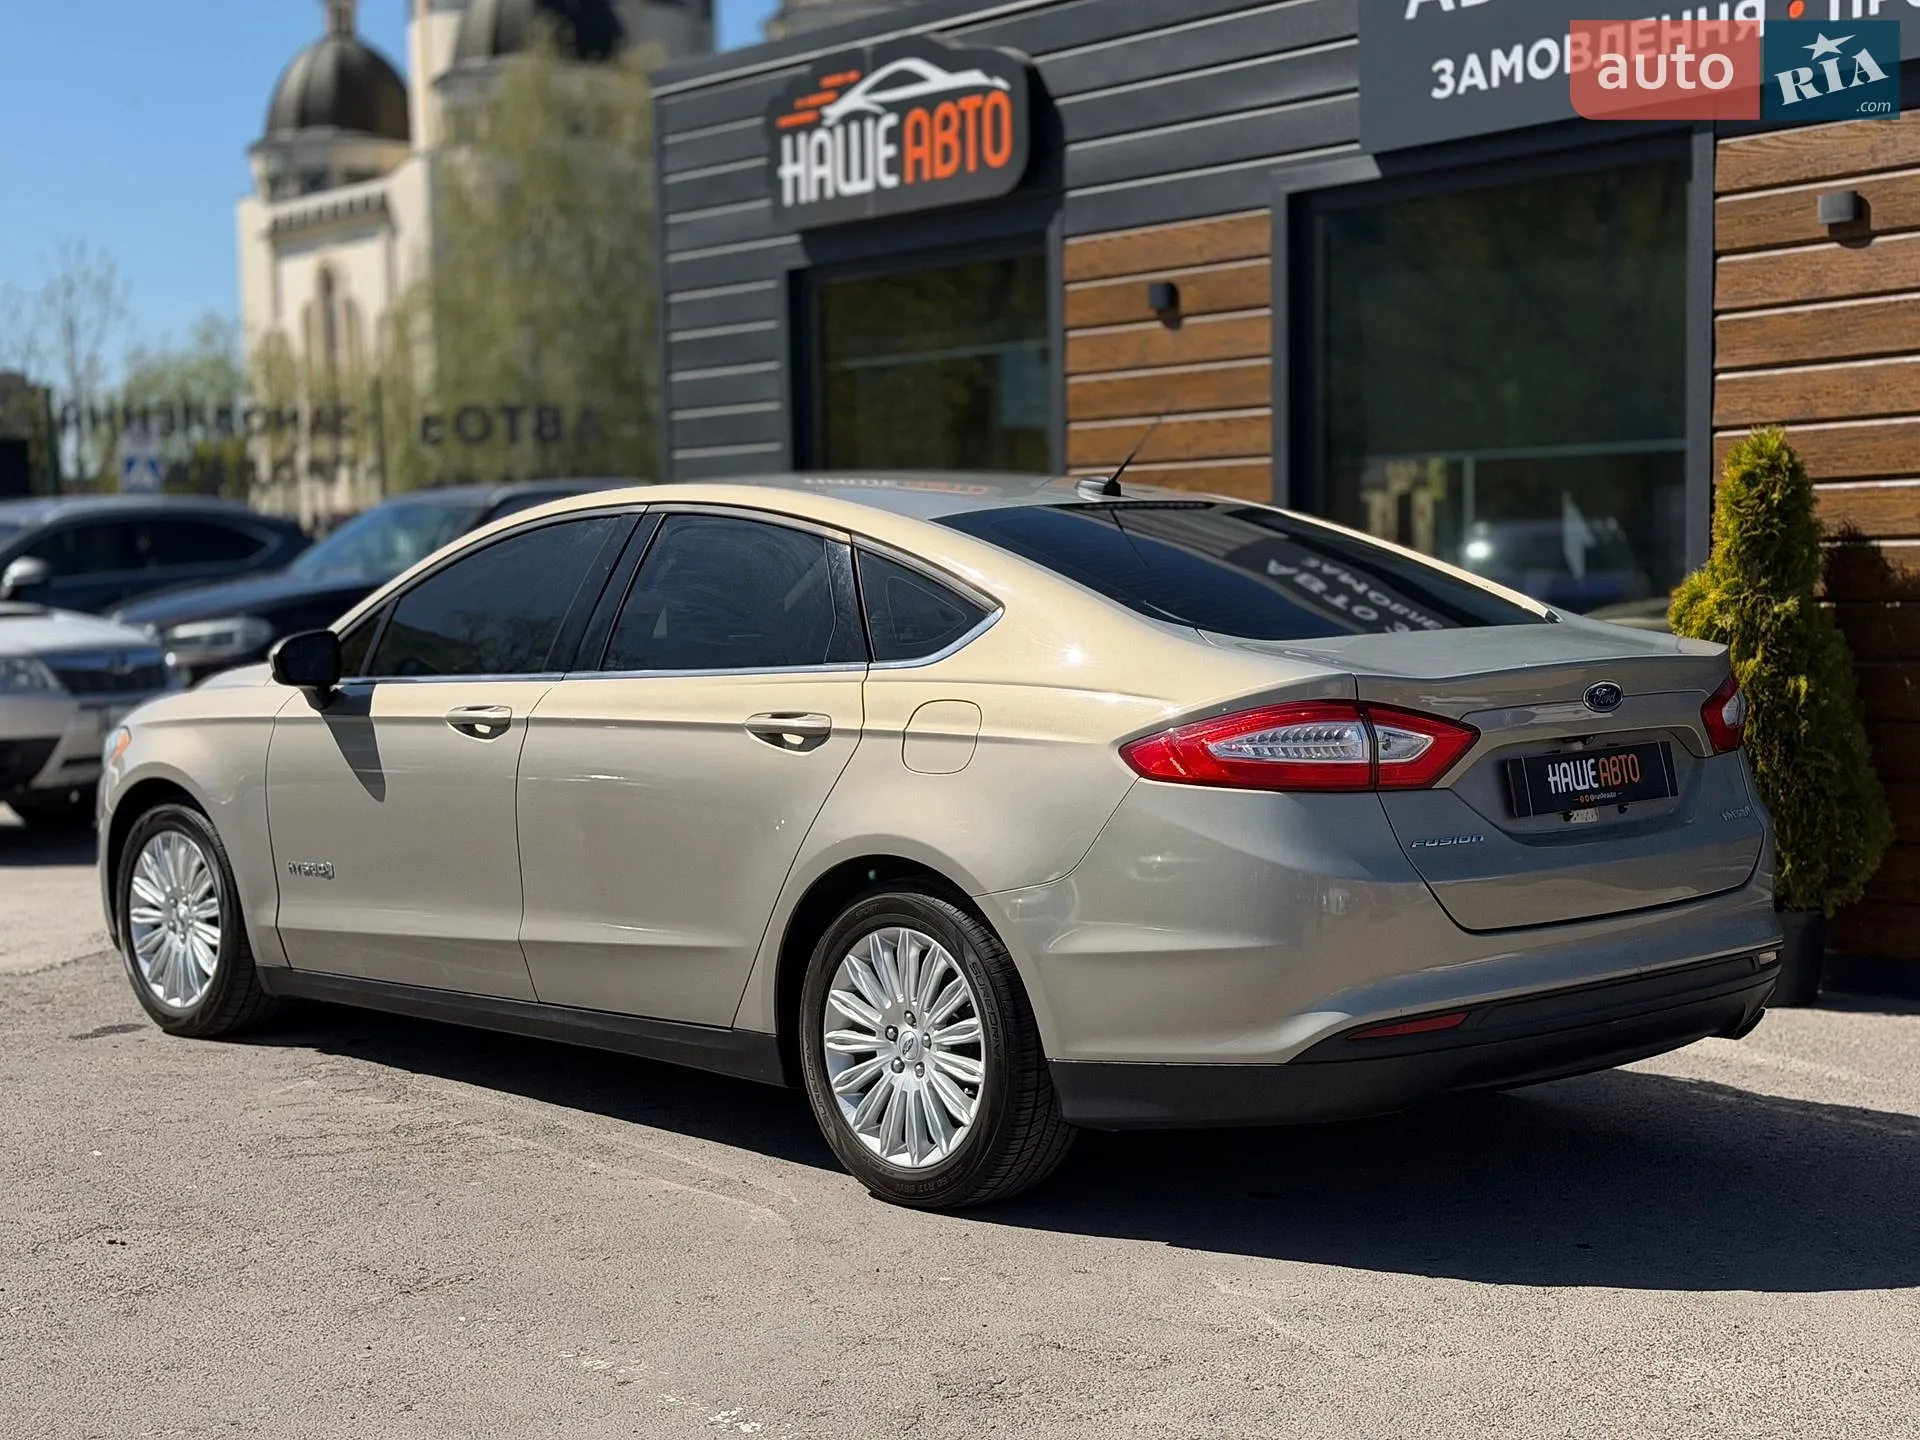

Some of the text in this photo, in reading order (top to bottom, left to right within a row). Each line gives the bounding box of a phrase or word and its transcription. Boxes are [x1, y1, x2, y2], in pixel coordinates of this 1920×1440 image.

[1431, 0, 1766, 99] ЗАМОВЛЕННЯ
[777, 89, 1013, 208] НАШЕ АВТО
[1547, 753, 1641, 794] НАШЕ АВТО
[1411, 834, 1484, 848] FUSION
